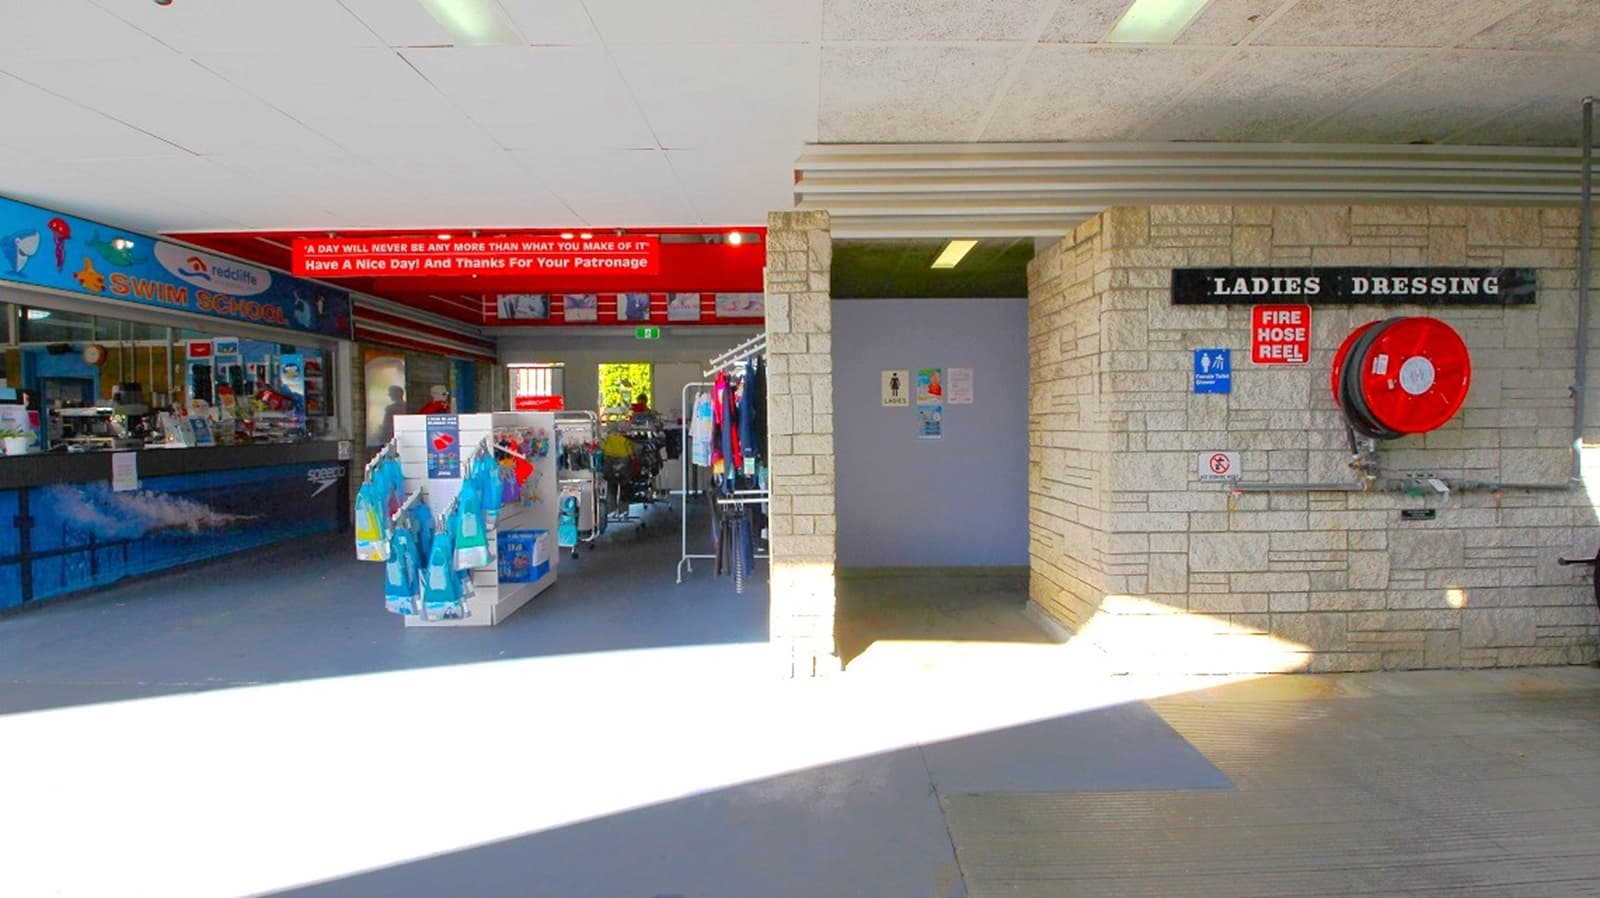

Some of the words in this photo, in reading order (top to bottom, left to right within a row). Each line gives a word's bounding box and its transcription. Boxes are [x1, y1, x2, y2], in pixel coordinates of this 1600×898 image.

[318, 244, 339, 253] DAY
[342, 244, 369, 253] WILL
[371, 243, 408, 252] NEVER
[411, 243, 425, 252] BE
[428, 243, 450, 252] ANY
[453, 242, 485, 251] MORE
[489, 242, 519, 251] THAN
[522, 242, 554, 251] WHAT
[557, 242, 580, 251] YOU
[583, 242, 614, 250] MAKE
[617, 242, 632, 250] OF
[305, 259, 339, 270] Have
[342, 259, 352, 270] A
[355, 258, 386, 270] Nice
[390, 258, 420, 271] Day!
[424, 258, 451, 269] And
[456, 258, 505, 269] Thanks
[509, 258, 533, 268] For
[537, 257, 570, 268] Your
[574, 257, 648, 269] Patronage
[211, 265, 257, 286] redcliffe
[1214, 277, 1320, 295] LADIES
[1352, 276, 1499, 295] DRESSING
[109, 272, 189, 306] SWIM
[197, 290, 289, 325] SCHOOL
[1262, 310, 1302, 325] FIRE
[1257, 327, 1305, 342] HOSE
[1259, 344, 1303, 359] REEL
[307, 466, 345, 483] speedo
